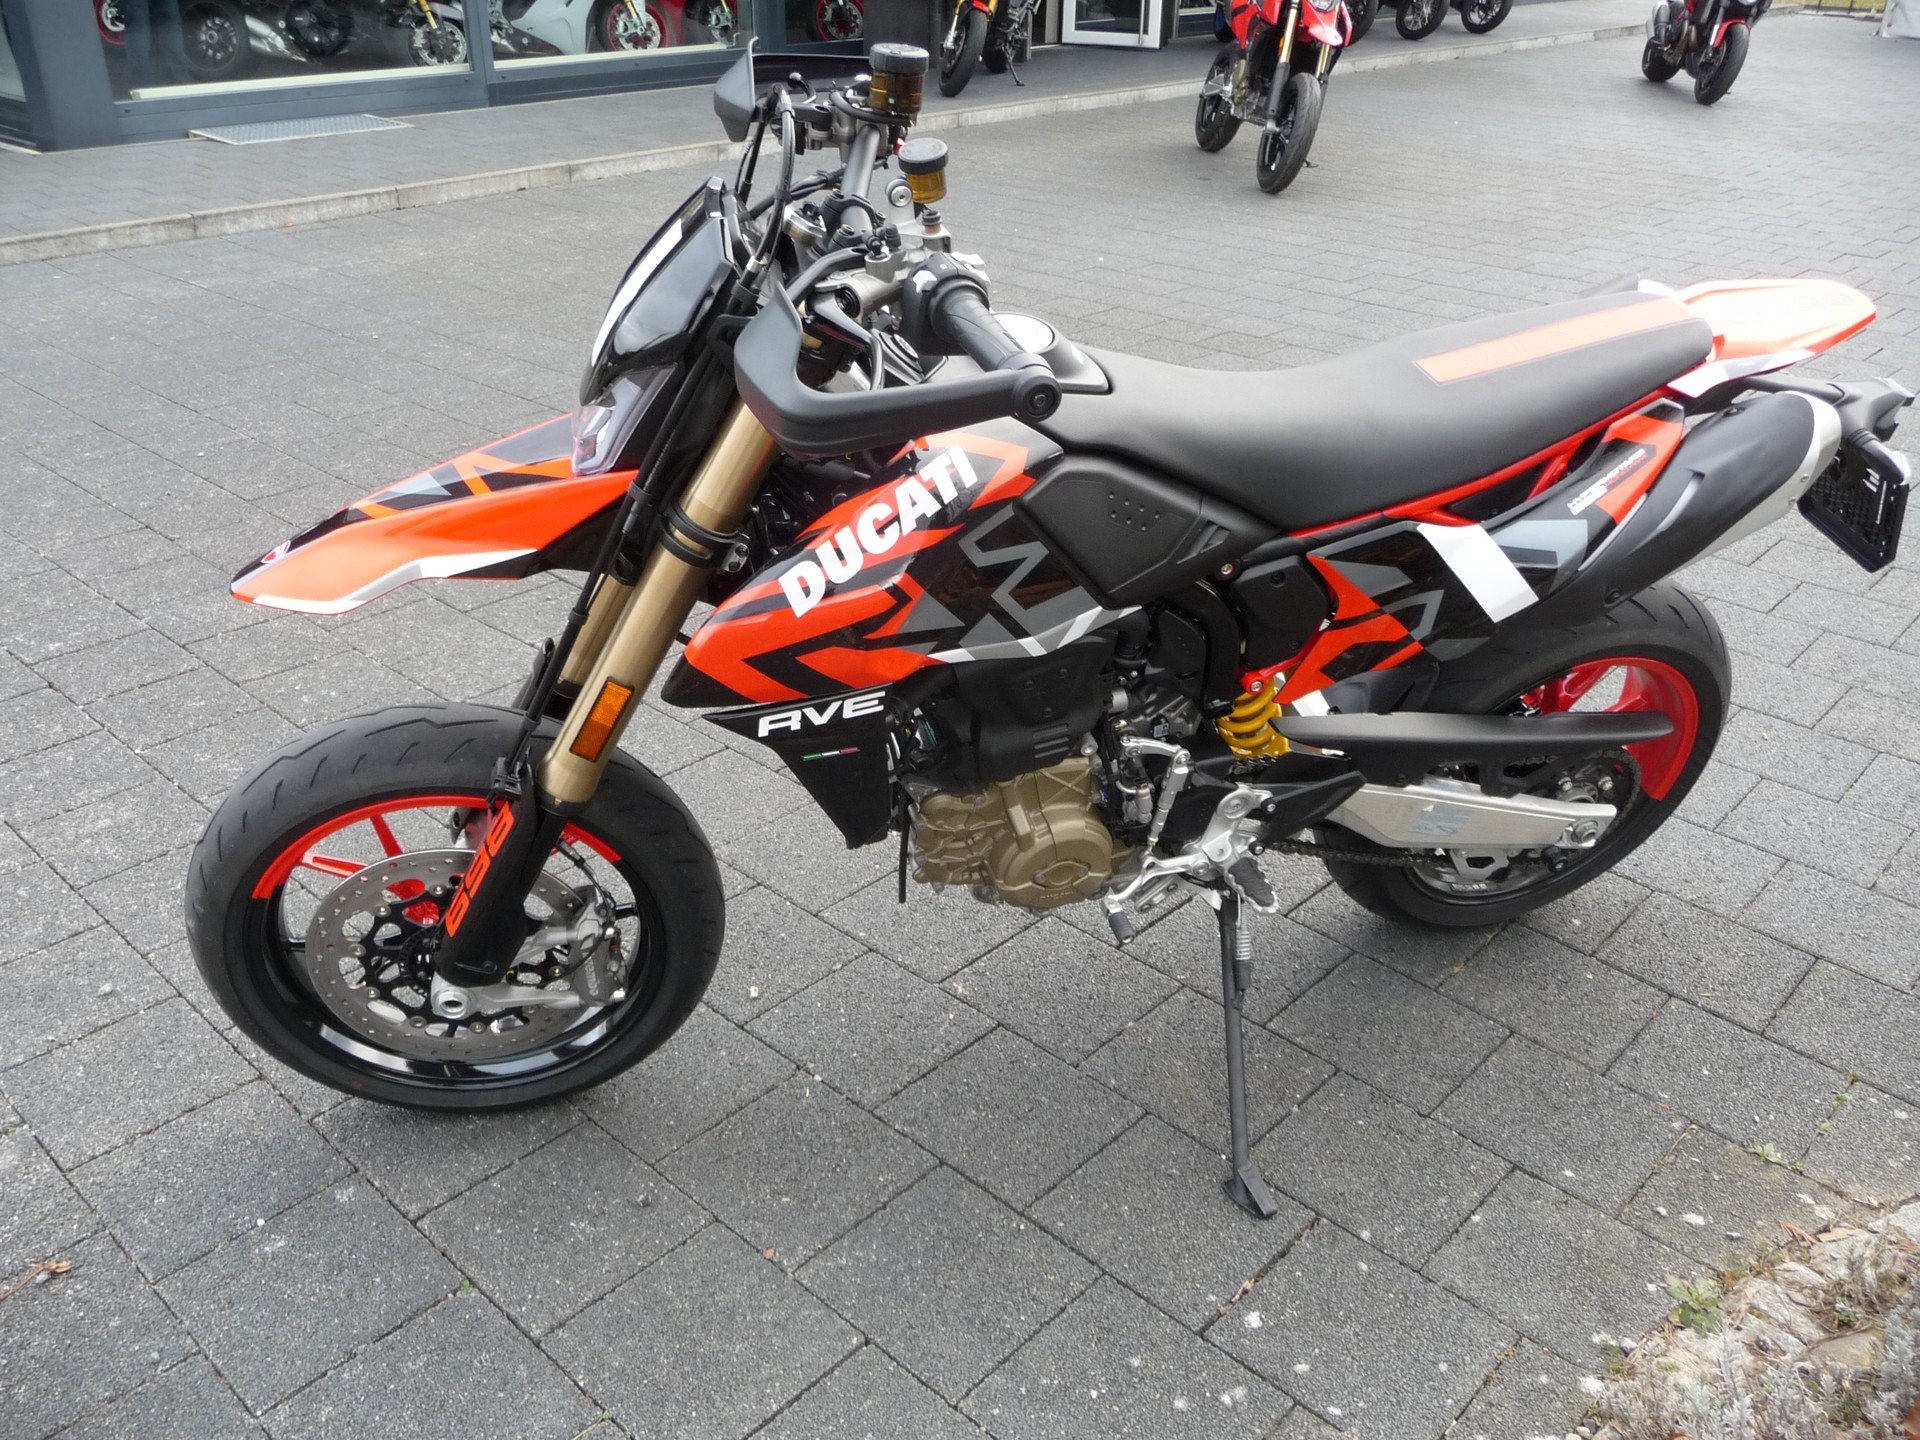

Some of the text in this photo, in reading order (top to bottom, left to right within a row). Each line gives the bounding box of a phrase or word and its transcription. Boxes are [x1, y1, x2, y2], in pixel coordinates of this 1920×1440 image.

[778, 444, 978, 618] DUCATI
[758, 691, 886, 738] RVE
[445, 801, 515, 937] 698
